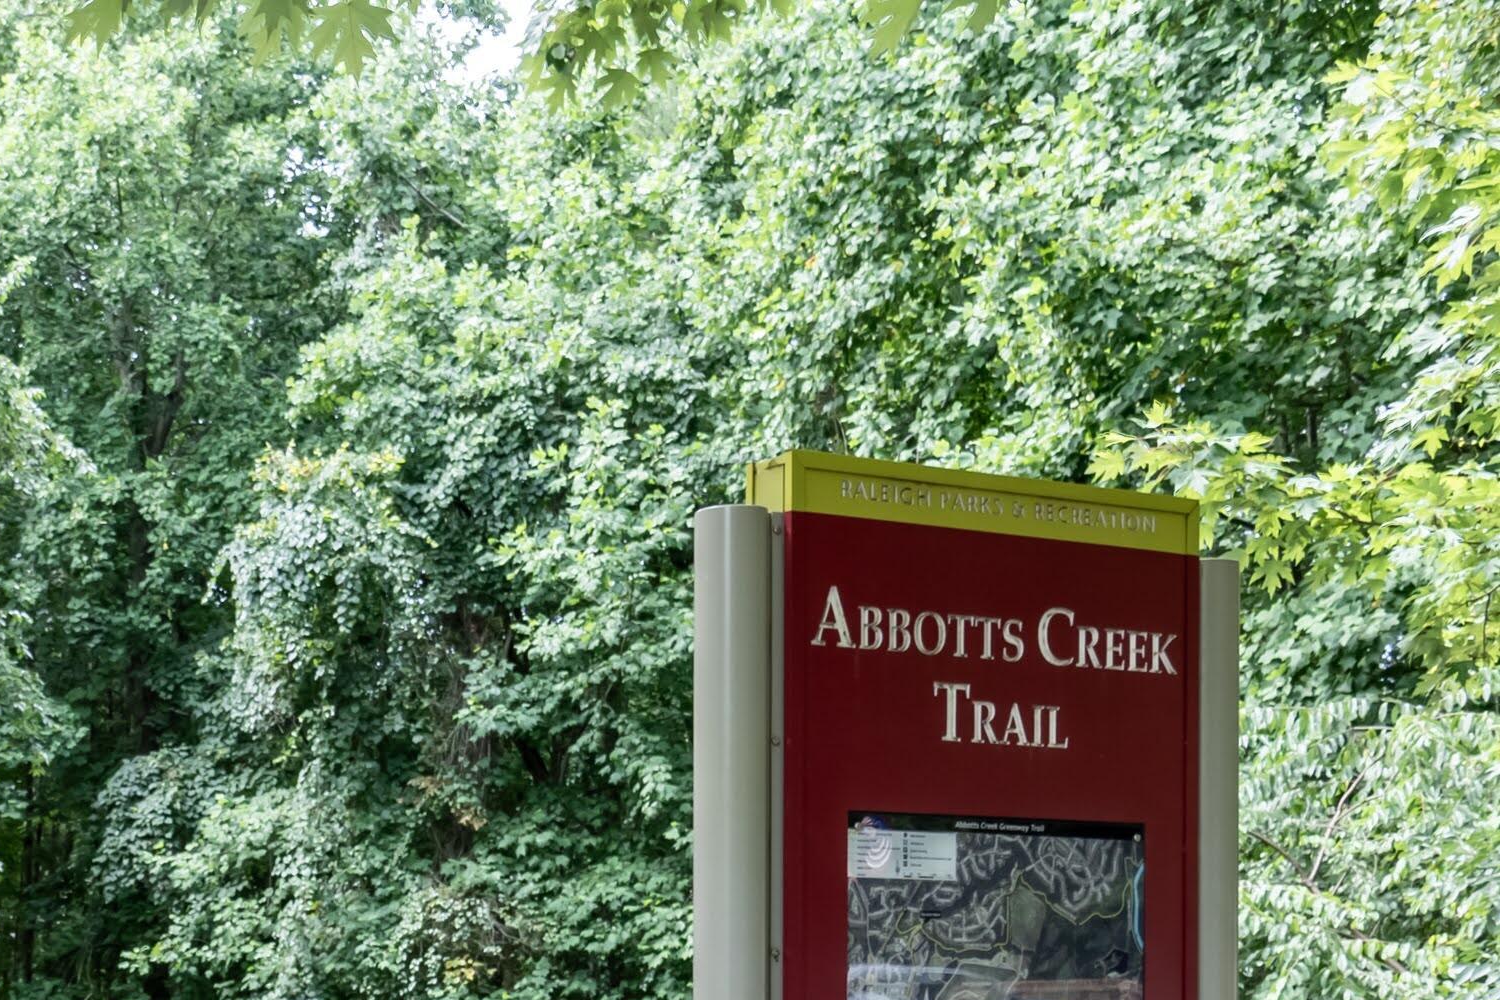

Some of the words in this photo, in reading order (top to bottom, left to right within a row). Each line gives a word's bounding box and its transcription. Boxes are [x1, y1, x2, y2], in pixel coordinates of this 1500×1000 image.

[841, 479, 931, 508] RALEIGH
[940, 493, 1004, 516] PARKS
[1012, 500, 1025, 518] &
[1035, 502, 1156, 533] RECREATION
[811, 585, 1025, 662] ABBOTTS
[1037, 607, 1177, 676] CREEK
[933, 681, 1069, 749] TRAIL
